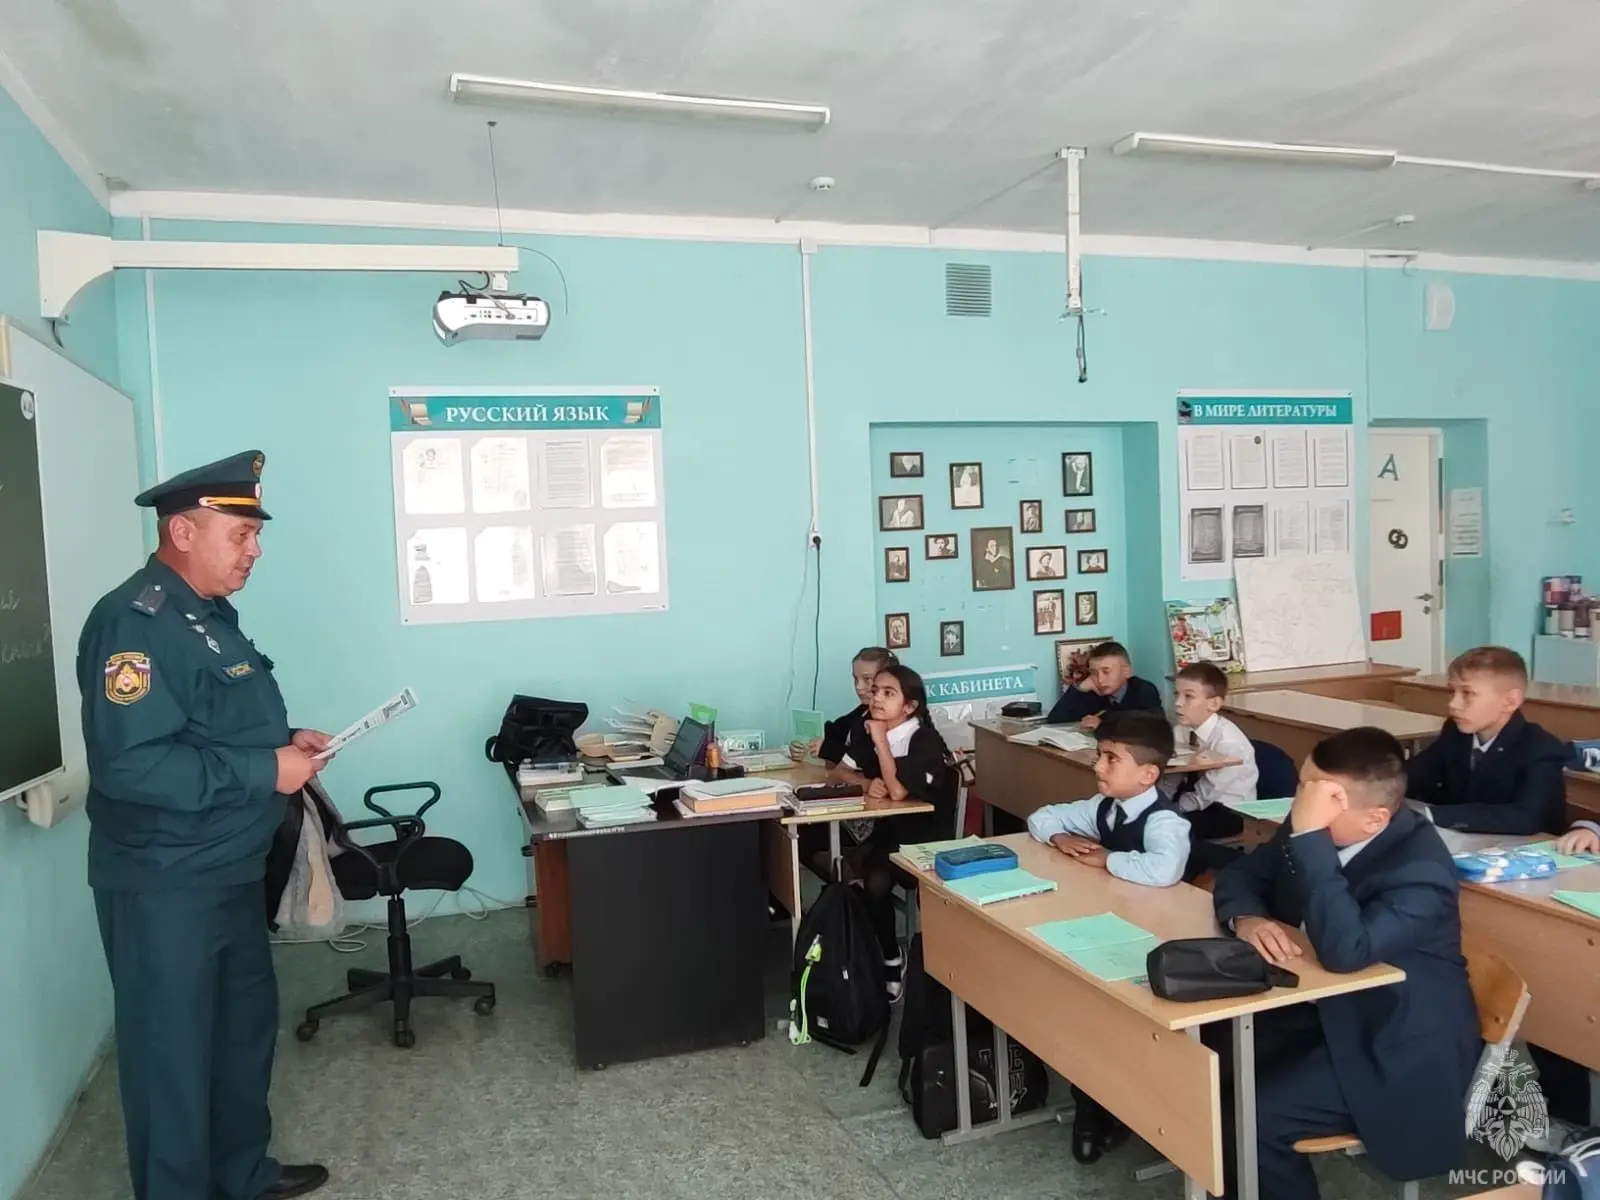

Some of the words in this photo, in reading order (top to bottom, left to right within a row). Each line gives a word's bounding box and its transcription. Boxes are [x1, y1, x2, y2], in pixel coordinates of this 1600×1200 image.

[446, 403, 548, 422] РУССКИЙ
[552, 406, 609, 421] ЯЗЫК
[1194, 404, 1203, 417] В
[1205, 404, 1246, 417] МИРЕ
[1248, 404, 1337, 418] ЛИТЕРАТУРЫ
[940, 675, 1024, 696] КАБИНЕТА
